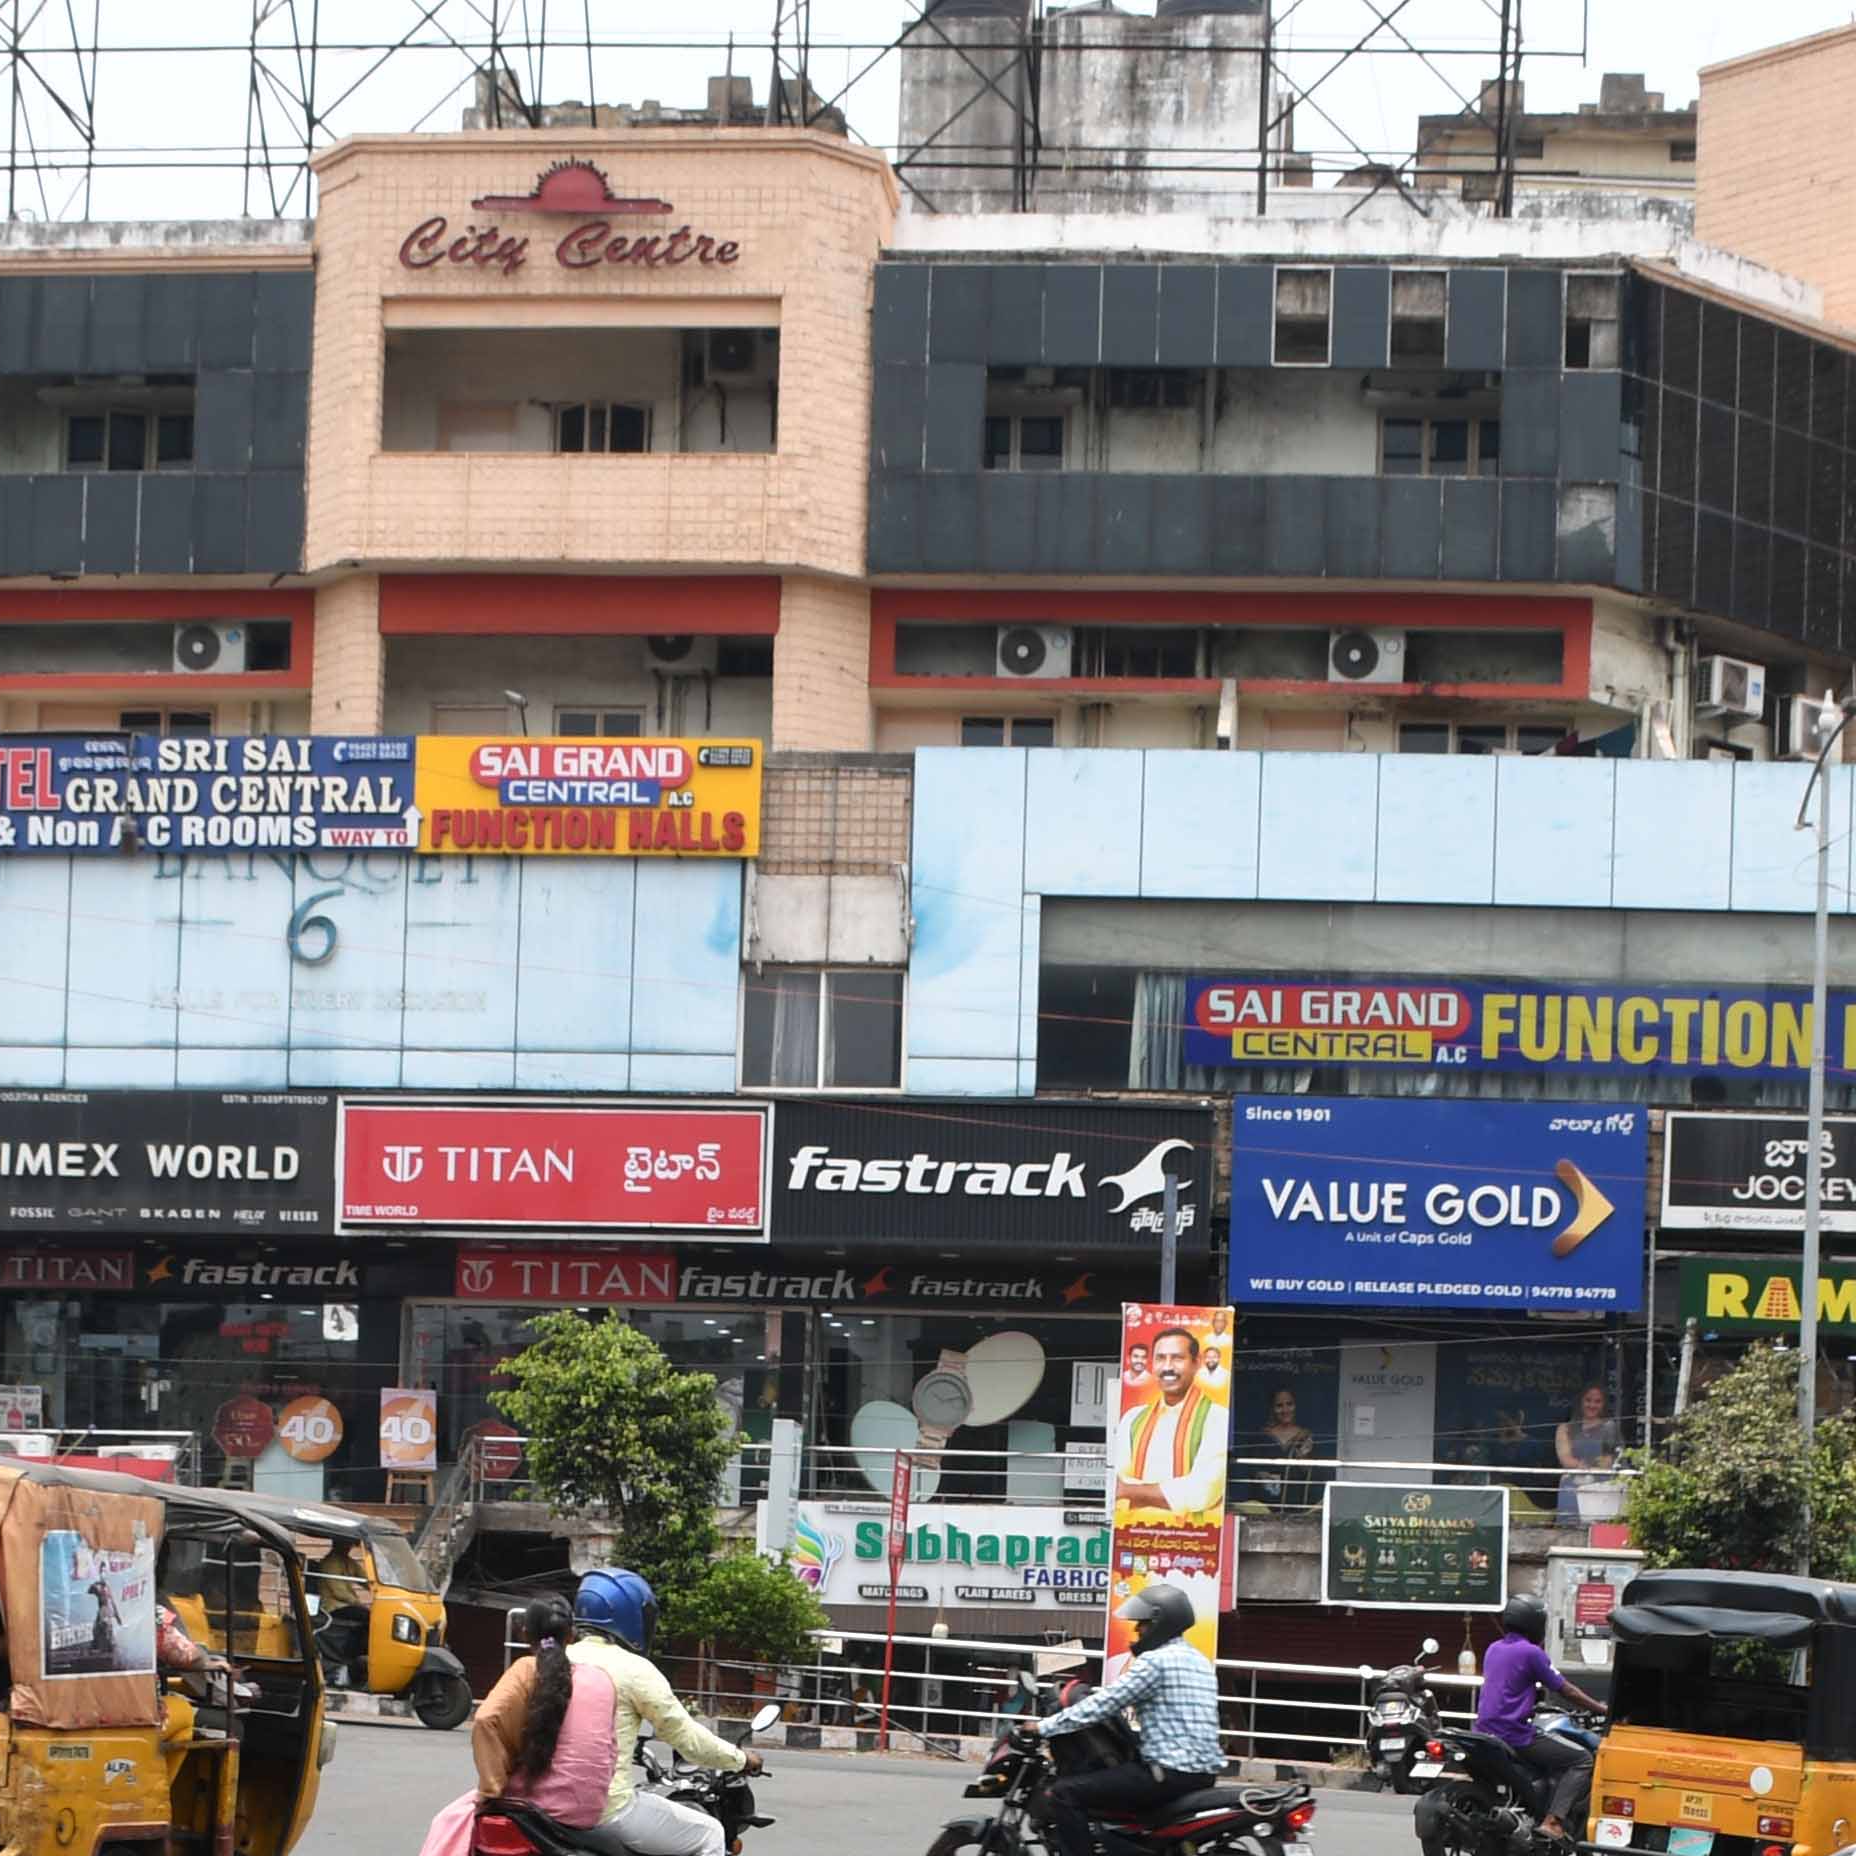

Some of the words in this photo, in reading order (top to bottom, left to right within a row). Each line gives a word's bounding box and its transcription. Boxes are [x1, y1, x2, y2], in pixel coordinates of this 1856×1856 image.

[398, 216, 529, 276] City
[555, 221, 741, 270] Centre
[158, 739, 229, 773] SRI
[242, 739, 312, 773] SAI
[478, 747, 539, 777] SAI
[552, 747, 684, 778] GRAND
[66, 777, 198, 814] GRAND
[211, 776, 402, 814] CENTRAL
[507, 780, 651, 804] CENTRAL
[667, 791, 695, 807] A.C
[28, 816, 100, 847] Non
[181, 817, 318, 847] ROOMS
[330, 830, 376, 845] WAY
[384, 830, 409, 845] TO
[430, 808, 617, 850] FUNCTION
[628, 809, 746, 851] HALLS
[1209, 989, 1282, 1025] SAI
[1300, 990, 1459, 1028] GRAND
[1481, 993, 1814, 1069] FUNCTION
[1242, 1030, 1424, 1058] CENTRAL
[1435, 1046, 1467, 1064] A.C
[1246, 1107, 1293, 1121] Since
[1296, 1107, 1332, 1122] 1901
[146, 1144, 300, 1181] WORLD
[437, 1146, 575, 1184] TITAN
[624, 1143, 722, 1193] టైటాన్
[787, 1145, 1087, 1198] fastrack
[10, 1206, 56, 1219] FOSSIL
[140, 1208, 221, 1219] SKAGEN
[345, 1204, 373, 1217] TIME
[375, 1204, 419, 1218] WORLD
[1261, 1178, 1407, 1225] VALUE
[1424, 1183, 1561, 1228] GOLD
[1345, 1233, 1355, 1243] A
[1357, 1232, 1383, 1244] Unit
[1384, 1232, 1397, 1244] of
[1398, 1231, 1435, 1247] Caps
[1437, 1231, 1473, 1246] Gold
[9, 1256, 124, 1282] TITAN
[183, 1258, 360, 1287] fastrack
[511, 1260, 672, 1297] TITAN
[679, 1267, 855, 1299] fastrack
[909, 1275, 1044, 1299] fastrack
[1250, 1278, 1273, 1290] WE
[1275, 1278, 1305, 1291] BUY
[1307, 1279, 1345, 1292] GOLD
[1354, 1281, 1415, 1295] RELEASE
[1417, 1282, 1482, 1296] PLEDGED
[1484, 1284, 1522, 1297] GOLD
[1531, 1285, 1572, 1298] 94778
[1574, 1286, 1616, 1299] 94778
[279, 1417, 334, 1443] 40
[379, 1416, 423, 1444] 40
[855, 1520, 1110, 1570] Sbhaprad
[861, 1587, 925, 1600] MATCINGS
[957, 1587, 990, 1600] PLAIN
[991, 1587, 1033, 1602] SAREES
[1058, 1591, 1094, 1603] DRESS
[106, 1762, 131, 1774] ALFA
